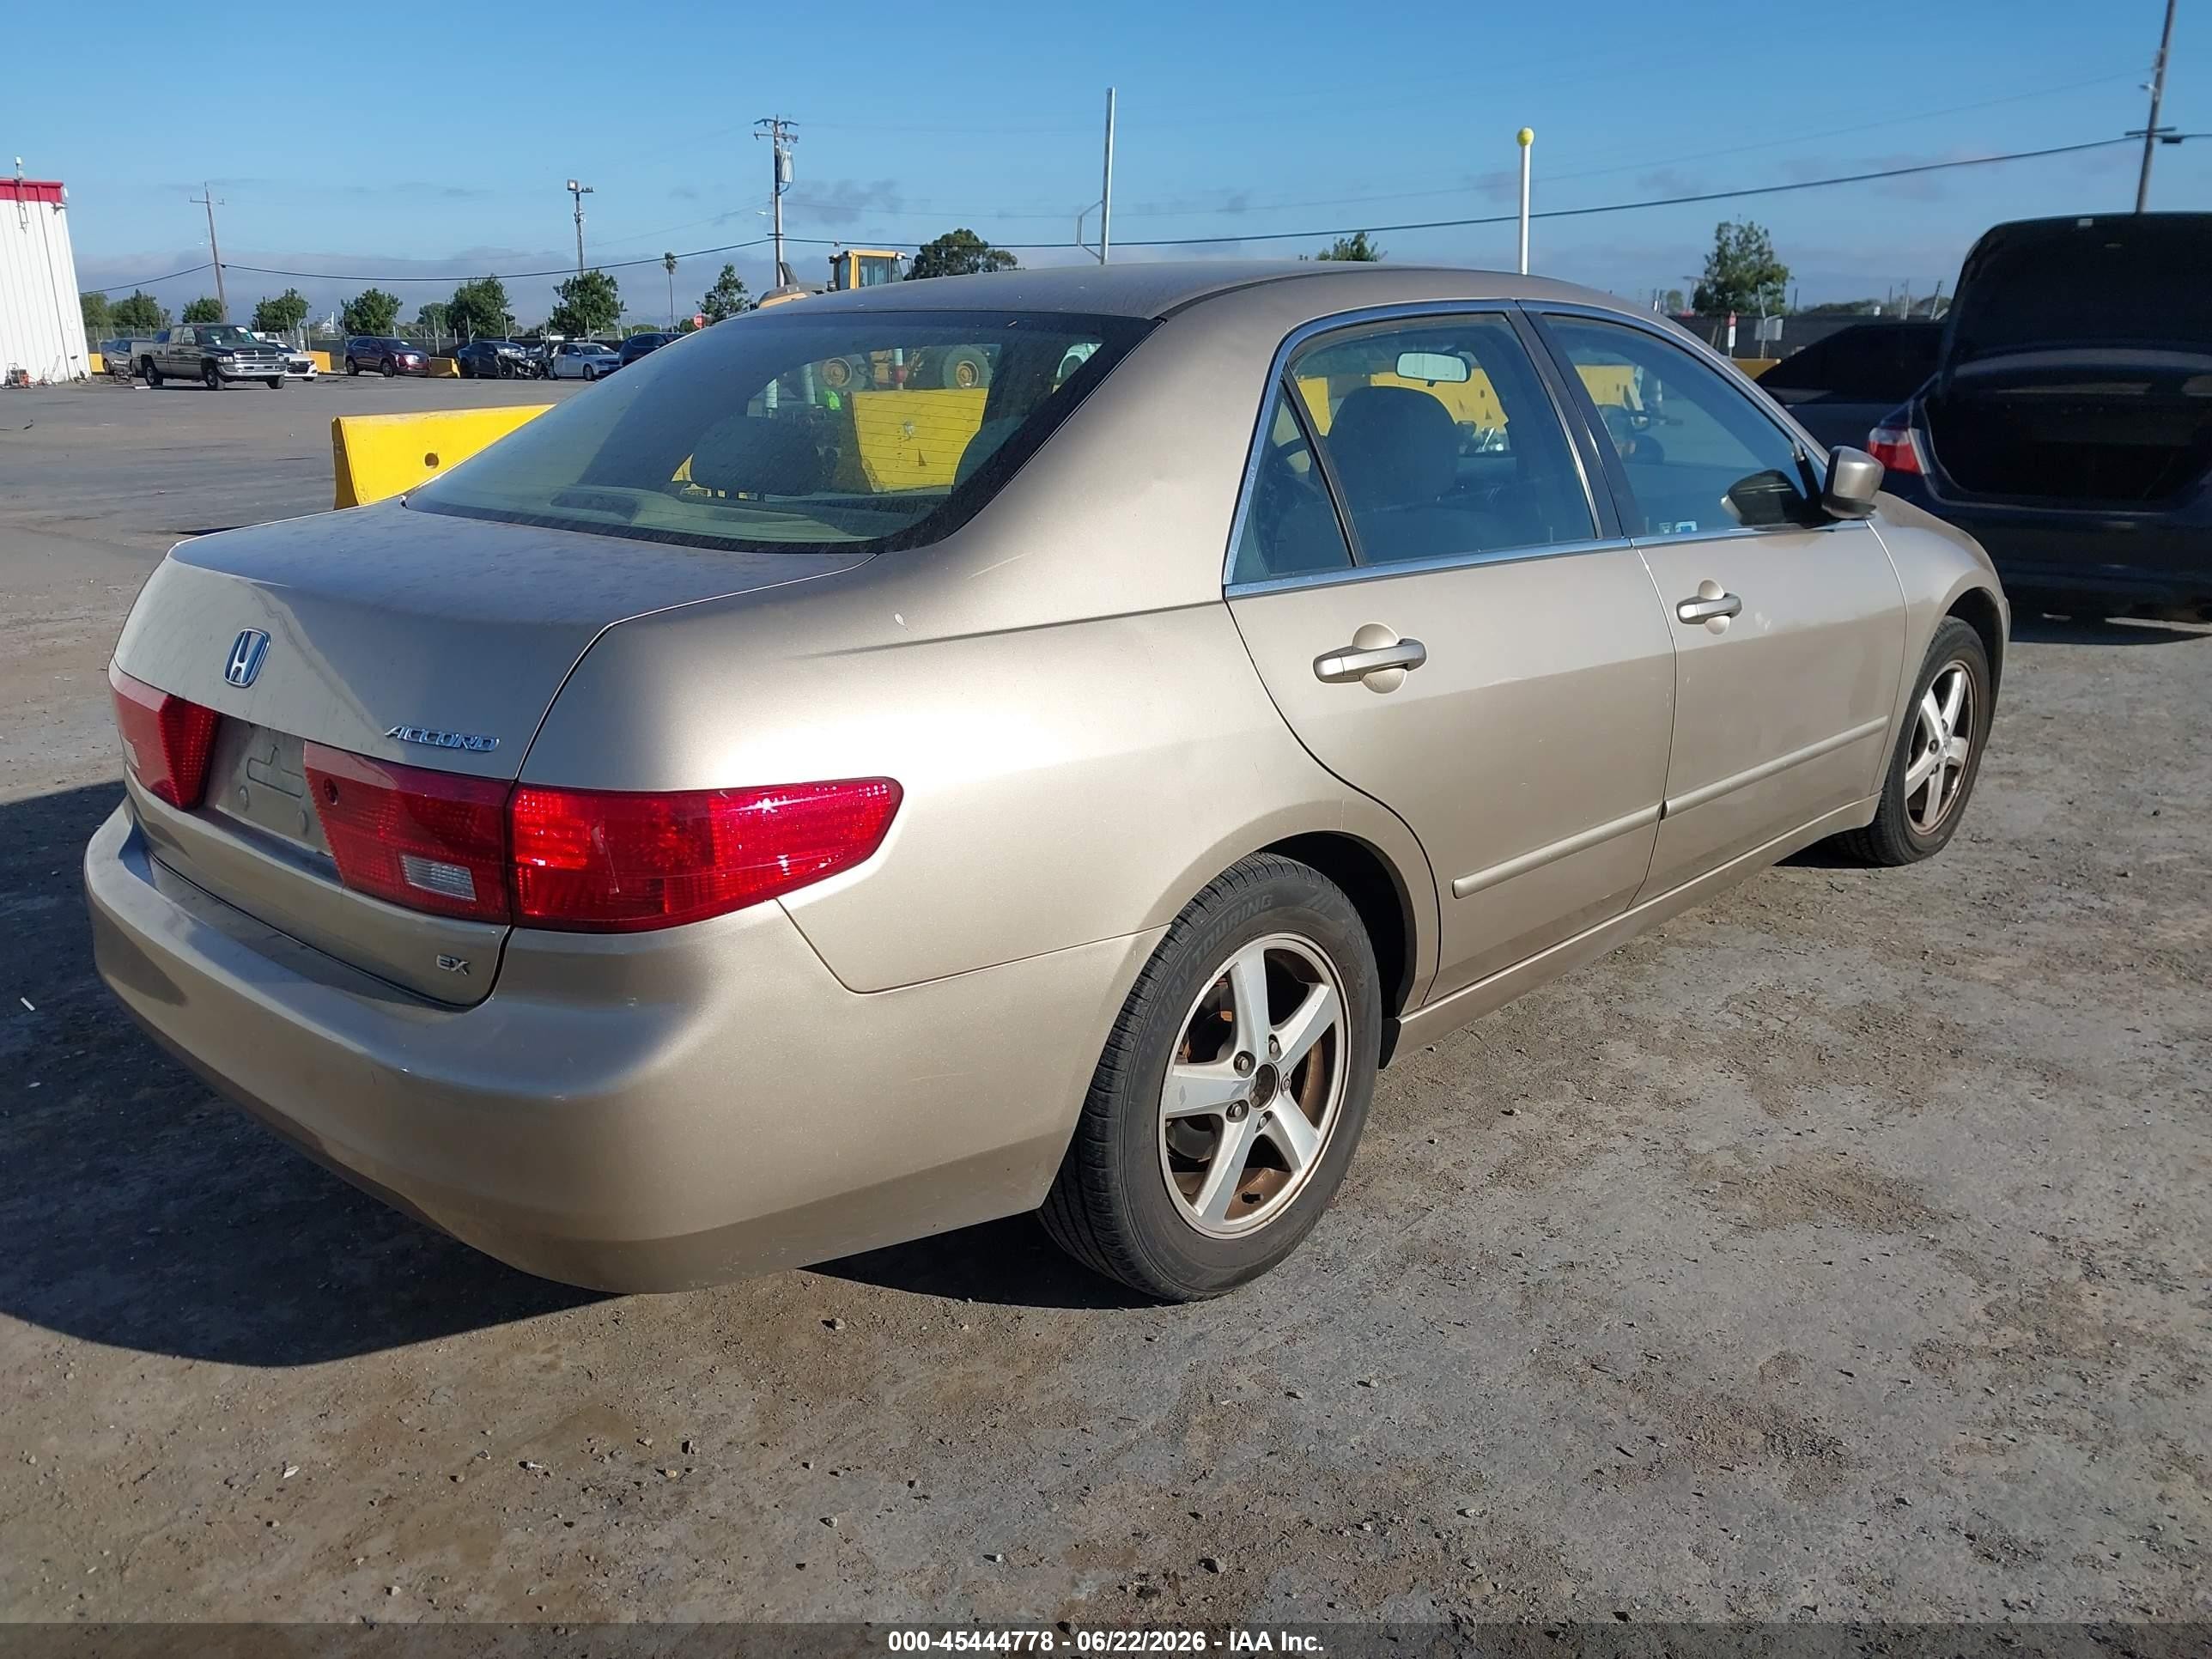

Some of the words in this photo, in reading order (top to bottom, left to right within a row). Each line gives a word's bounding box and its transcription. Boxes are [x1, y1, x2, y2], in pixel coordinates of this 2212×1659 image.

[385, 726, 501, 751] ACCORD
[1191, 894, 1273, 965] TOURING
[436, 953, 469, 975] EX
